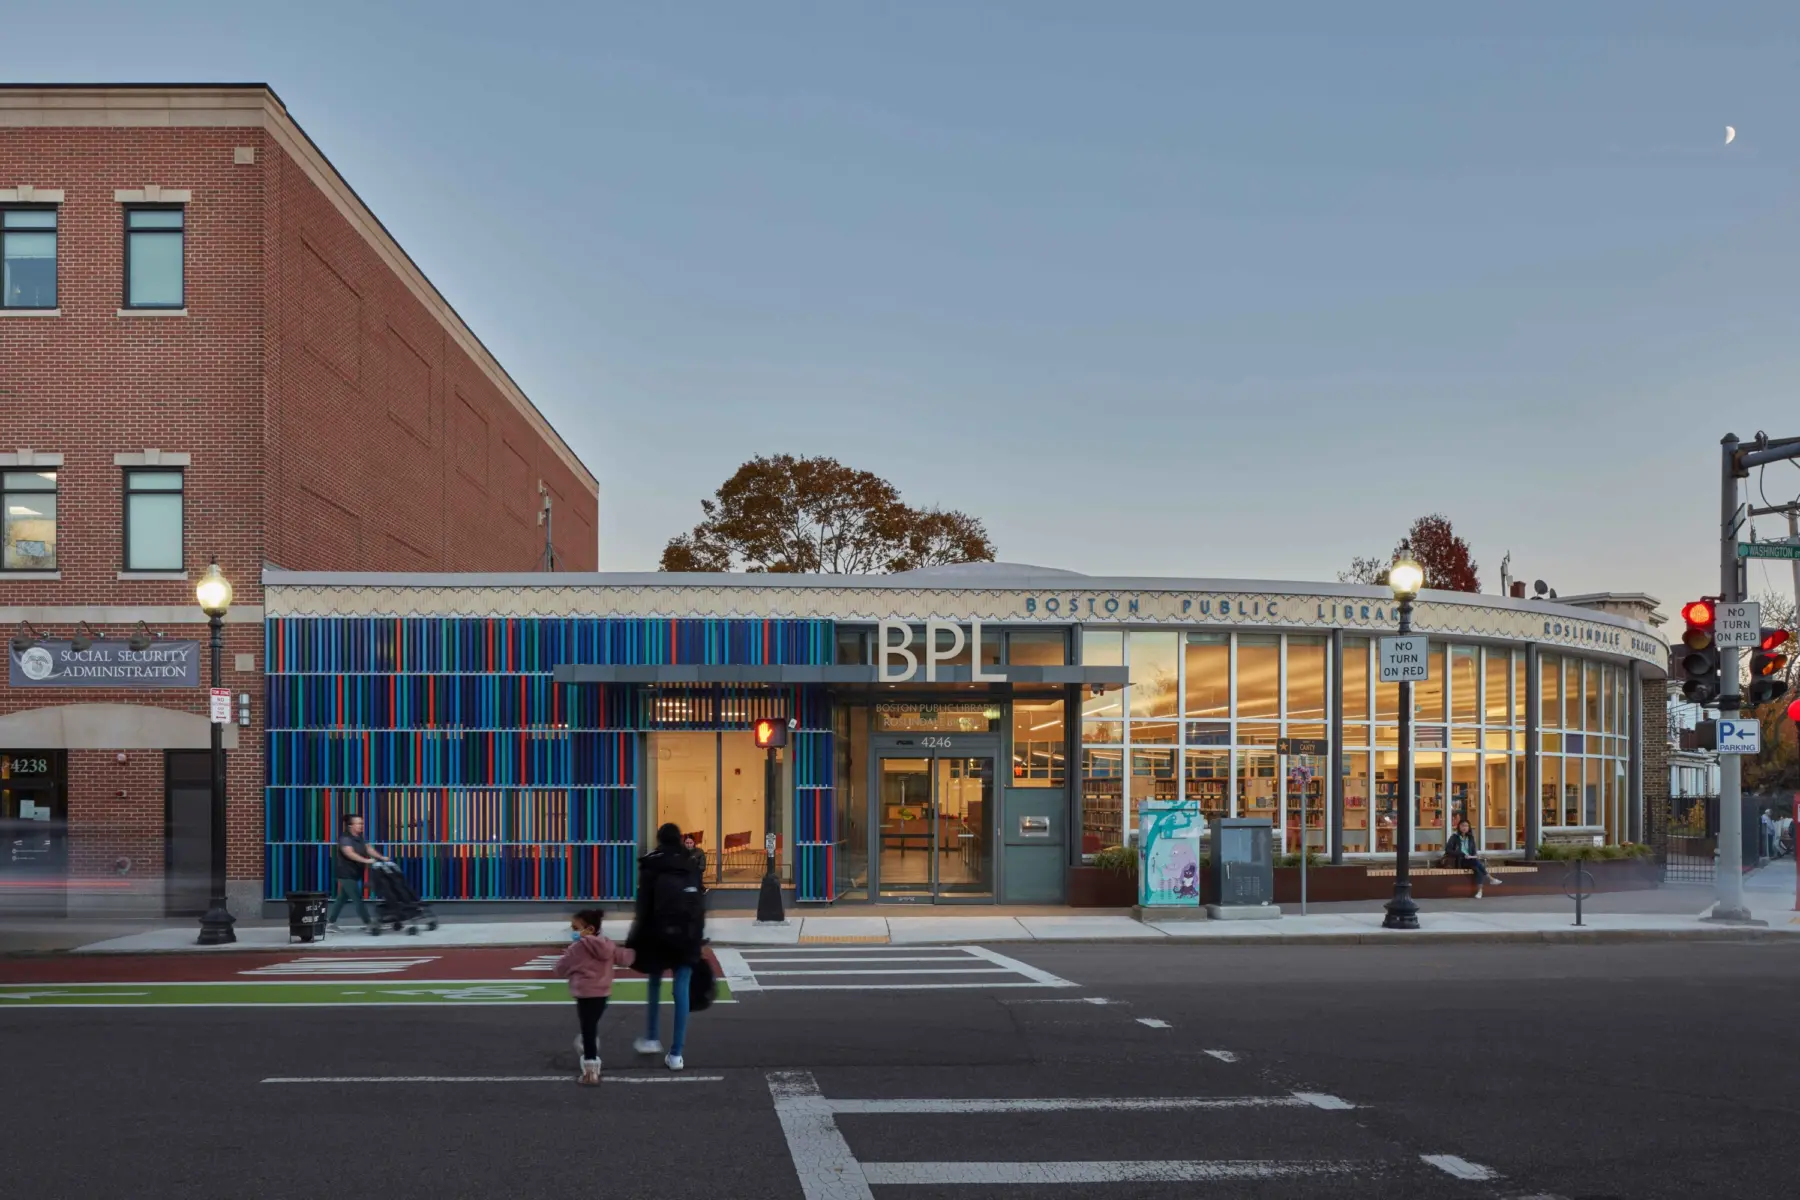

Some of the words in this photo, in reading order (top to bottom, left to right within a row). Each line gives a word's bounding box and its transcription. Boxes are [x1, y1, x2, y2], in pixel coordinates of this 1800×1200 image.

[1749, 545, 1793, 557] WASHINGTON
[1026, 598, 1138, 612] BOSTON
[1182, 599, 1278, 616] PUBLIC
[1317, 603, 1400, 621] LIBRAR
[1727, 607, 1745, 616] NO
[1723, 620, 1751, 629] TURN
[1543, 621, 1620, 645] ROSLINDALE
[1716, 632, 1731, 641] ON
[1735, 632, 1757, 641] RED
[878, 620, 1007, 682] BPL
[1395, 641, 1413, 651] NO
[60, 650, 112, 662] SOCIAL
[117, 650, 189, 662] SECURITY
[1389, 654, 1418, 664] TURN
[63, 666, 187, 678] ADMINISTRATION
[1383, 667, 1399, 677] ON
[1402, 666, 1424, 676] RED
[876, 703, 917, 713] BOSTON
[919, 703, 954, 713] PUBLIC
[1719, 722, 1735, 744] P
[921, 736, 952, 748] 4246
[11, 758, 48, 773] 4238
